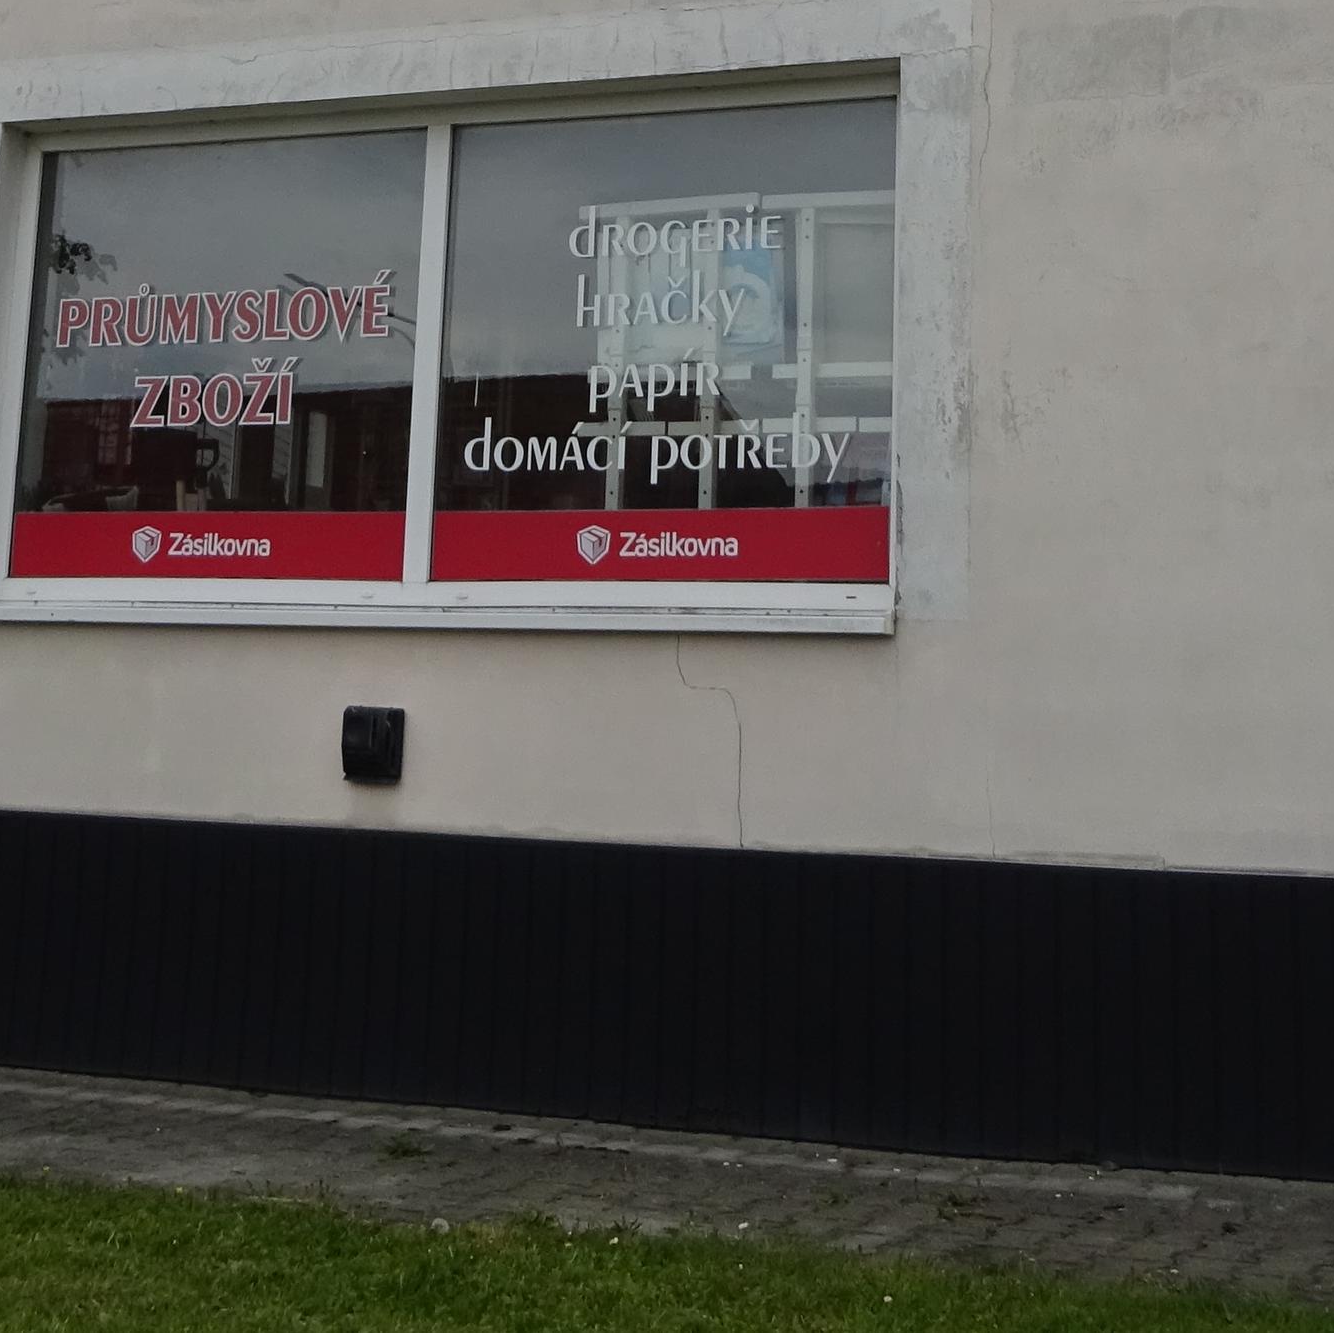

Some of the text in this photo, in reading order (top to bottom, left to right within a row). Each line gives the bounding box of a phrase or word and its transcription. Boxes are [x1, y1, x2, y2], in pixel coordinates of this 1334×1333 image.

[56, 269, 397, 348] PRŮMYSLOVÉ
[130, 356, 299, 428] ZBOŽÍ
[167, 532, 271, 557] Zásilkovna
[619, 531, 739, 558] Zásilkovna
